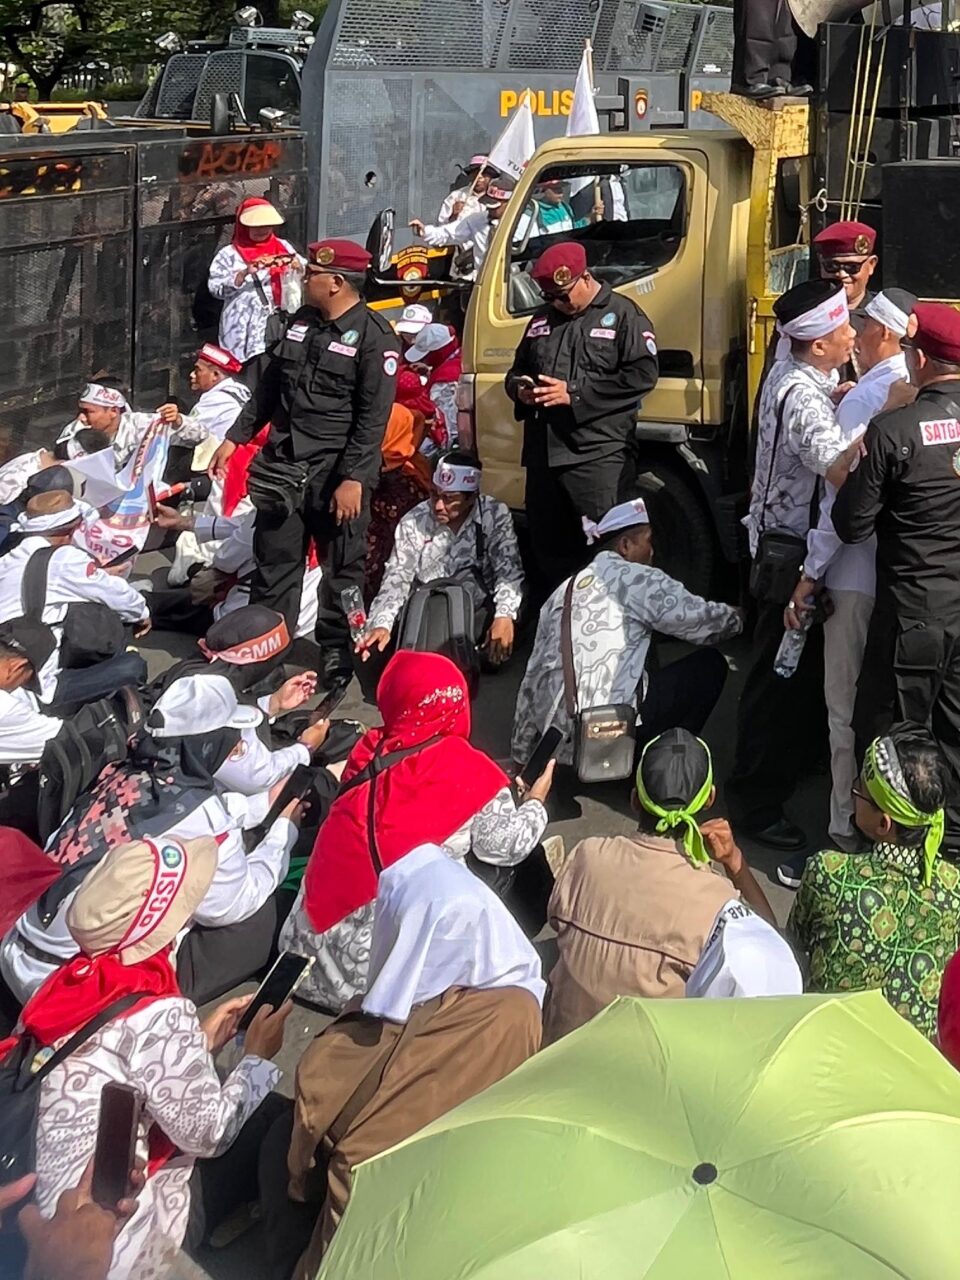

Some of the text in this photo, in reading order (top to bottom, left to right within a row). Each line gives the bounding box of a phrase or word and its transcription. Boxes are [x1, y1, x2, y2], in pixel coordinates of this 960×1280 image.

[500, 90, 576, 117] POLIS
[95, 389, 120, 401] PGSI
[139, 871, 179, 928] PGSI
